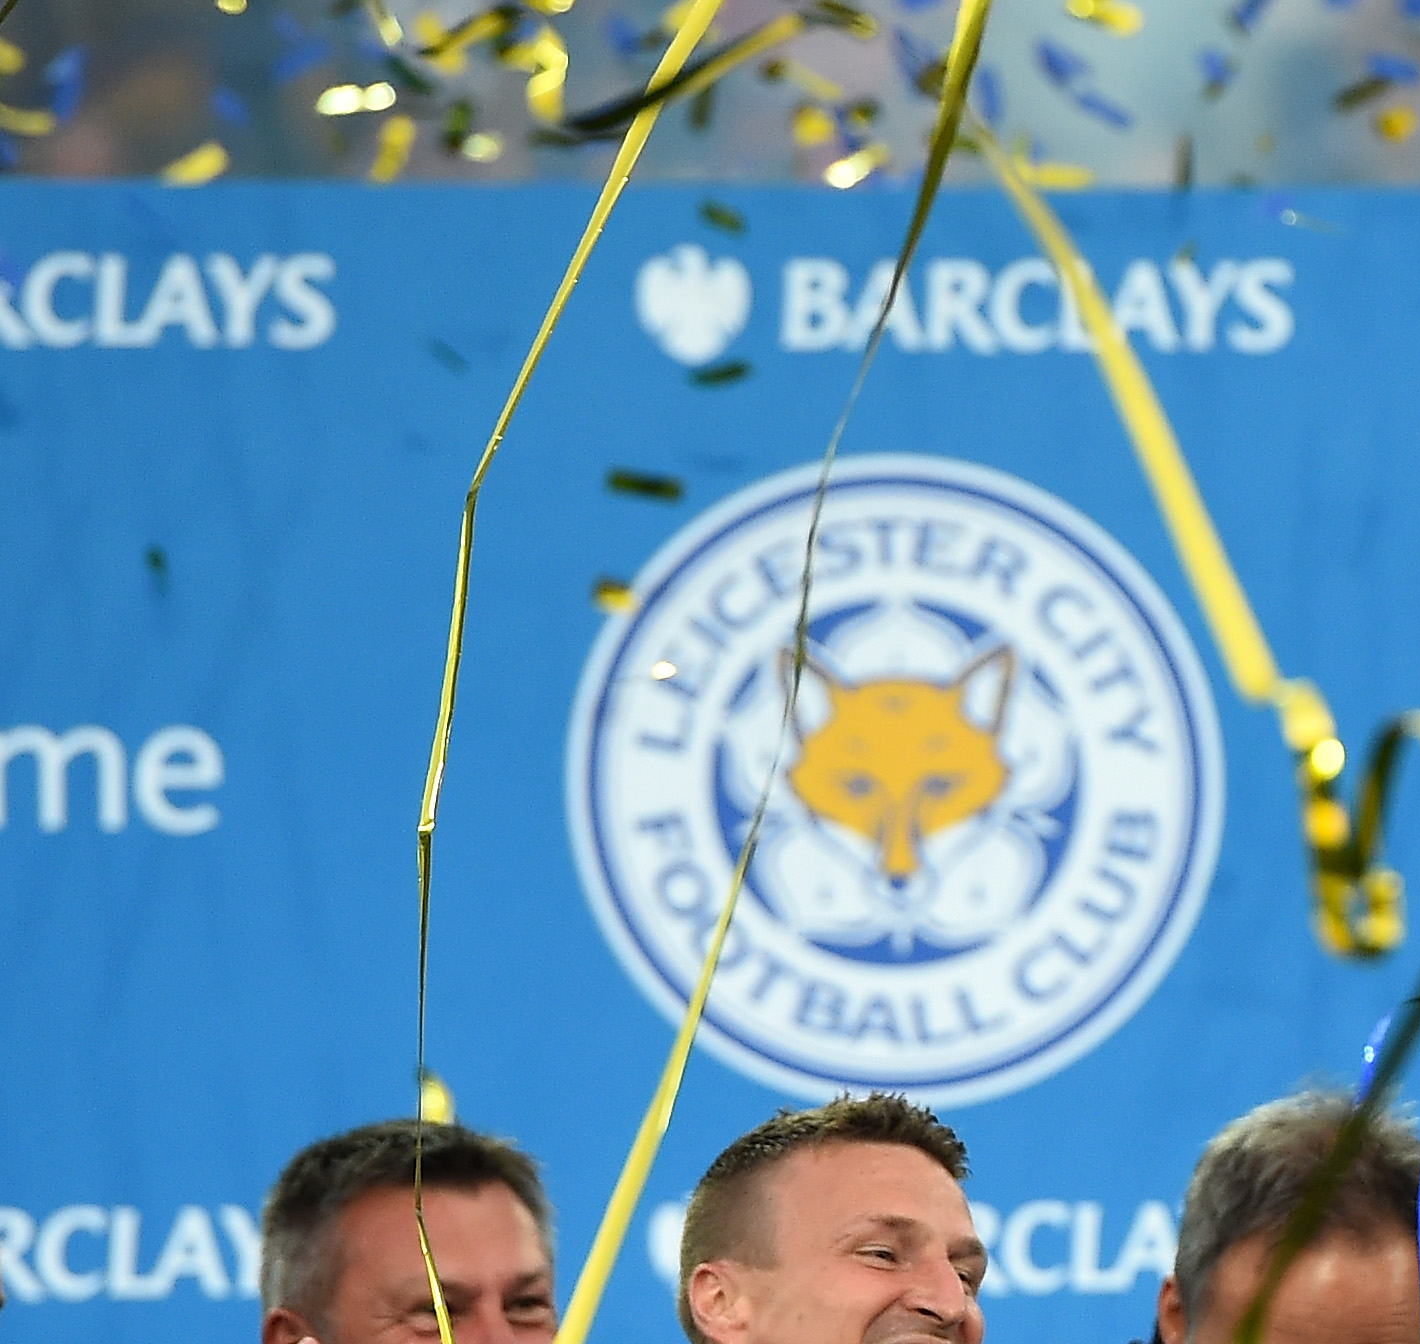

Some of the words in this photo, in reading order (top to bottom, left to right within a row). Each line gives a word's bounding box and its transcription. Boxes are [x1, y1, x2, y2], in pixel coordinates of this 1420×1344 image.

[779, 256, 1297, 355] BARCLAYS
[636, 515, 1036, 756] LEICESTER
[1038, 584, 1163, 757] CITY
[634, 808, 1002, 1048] FOOTBALL
[1010, 808, 1160, 1004] CLUB
